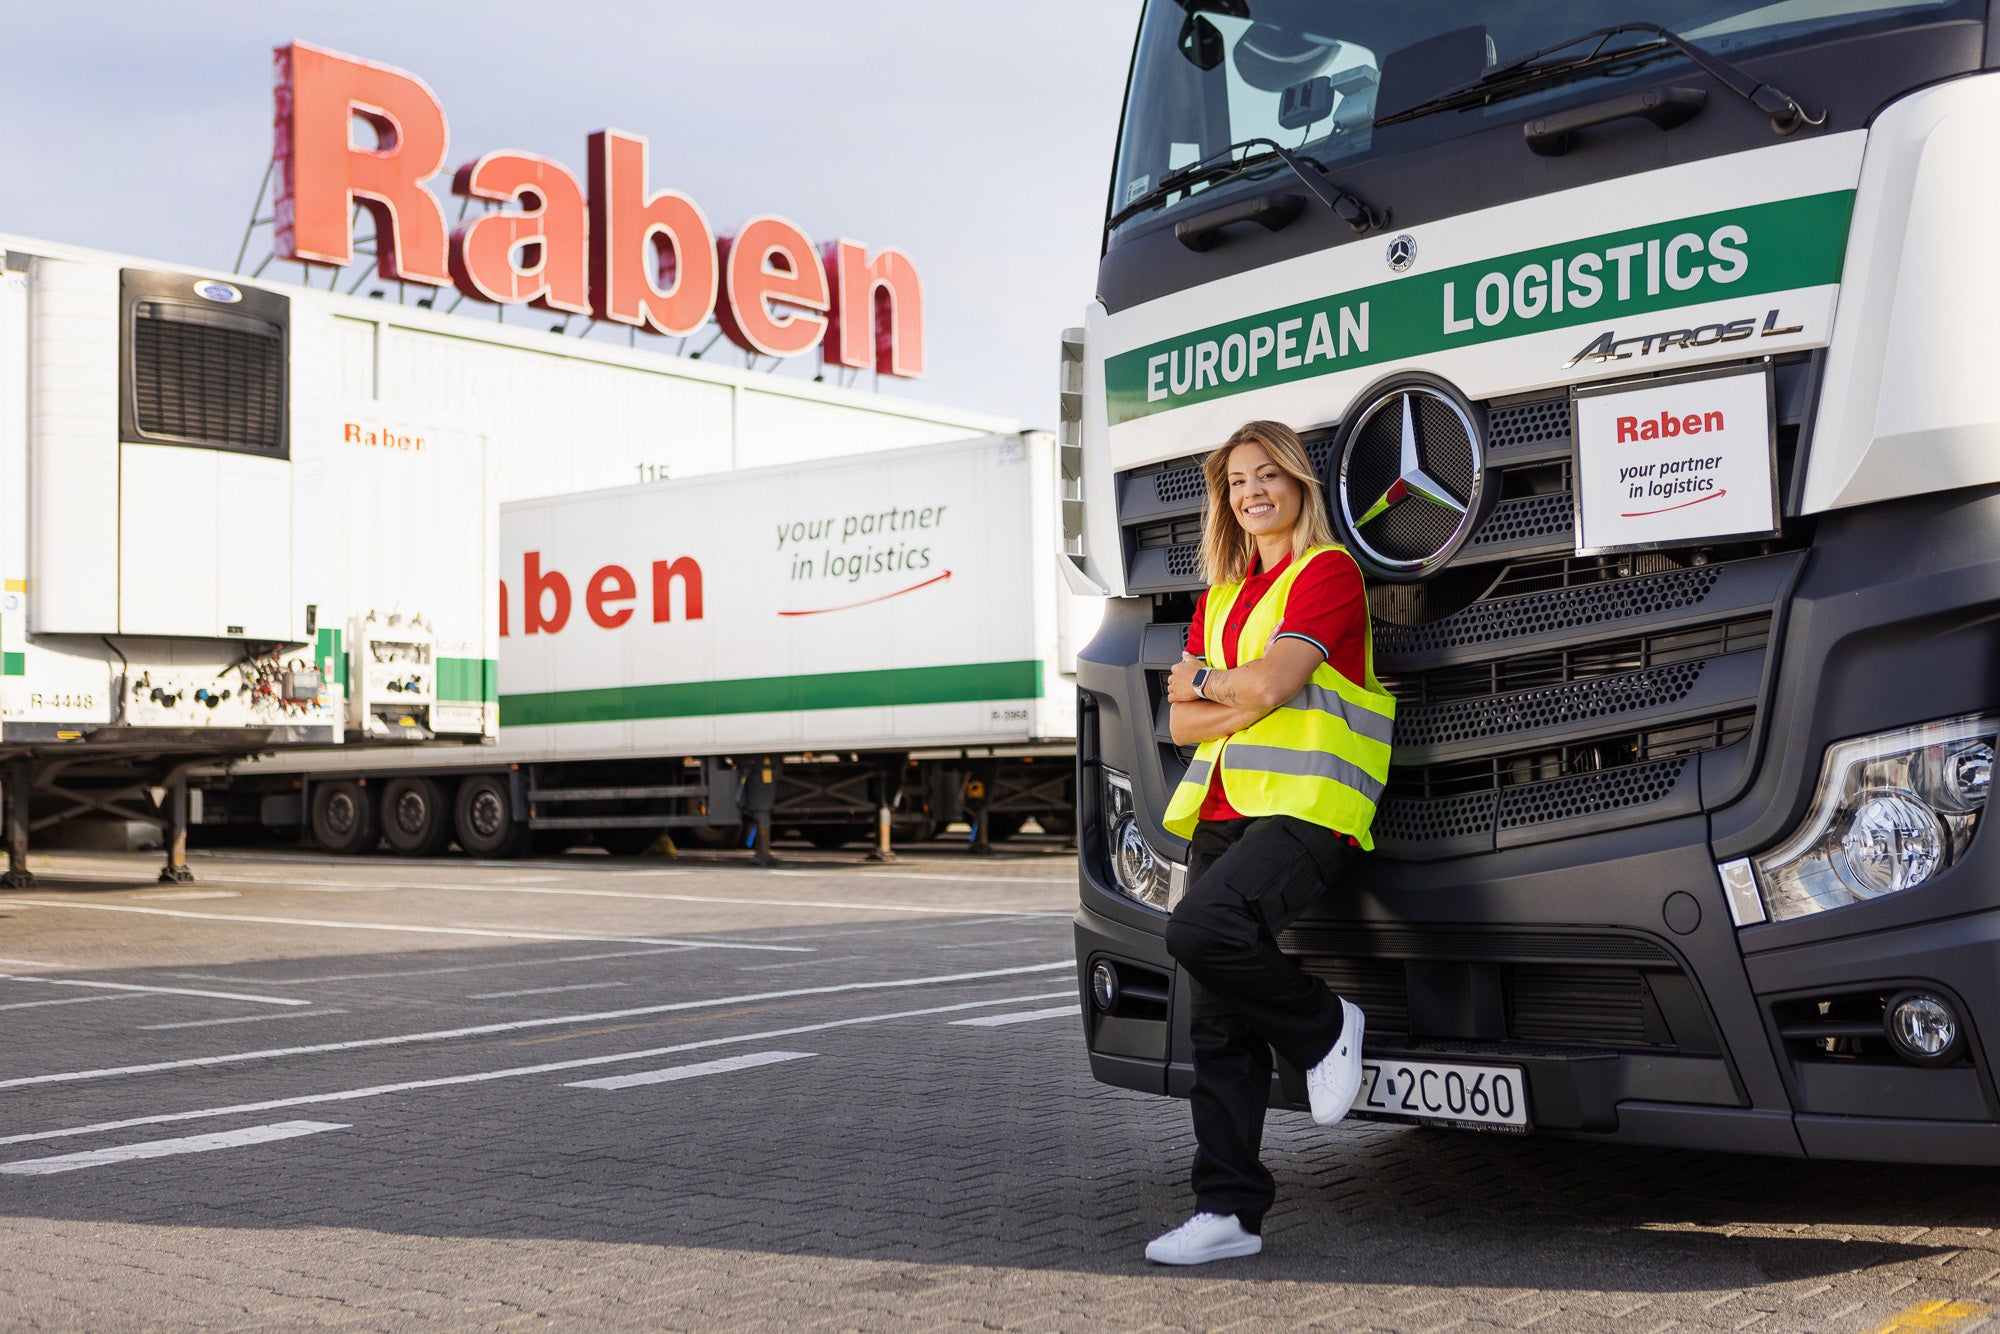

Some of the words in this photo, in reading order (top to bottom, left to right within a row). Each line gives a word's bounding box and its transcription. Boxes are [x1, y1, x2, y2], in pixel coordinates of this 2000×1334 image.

[273, 39, 926, 380] Raben
[1147, 301, 1370, 403] EUROPEAN
[1443, 225, 1749, 335] LOGISTICS
[1561, 317, 1757, 370] ACTROS
[1761, 309, 1804, 337] L
[344, 422, 426, 454] Raben
[1616, 410, 1725, 444] Raben
[1619, 464, 1656, 483] your
[1659, 456, 1722, 479] partner
[1628, 483, 1644, 499] in
[1648, 476, 1714, 498] logistics
[776, 518, 834, 551] your
[842, 505, 947, 544] partner
[791, 553, 813, 580] in
[823, 542, 933, 582] logistics
[31, 693, 93, 710] R-4448
